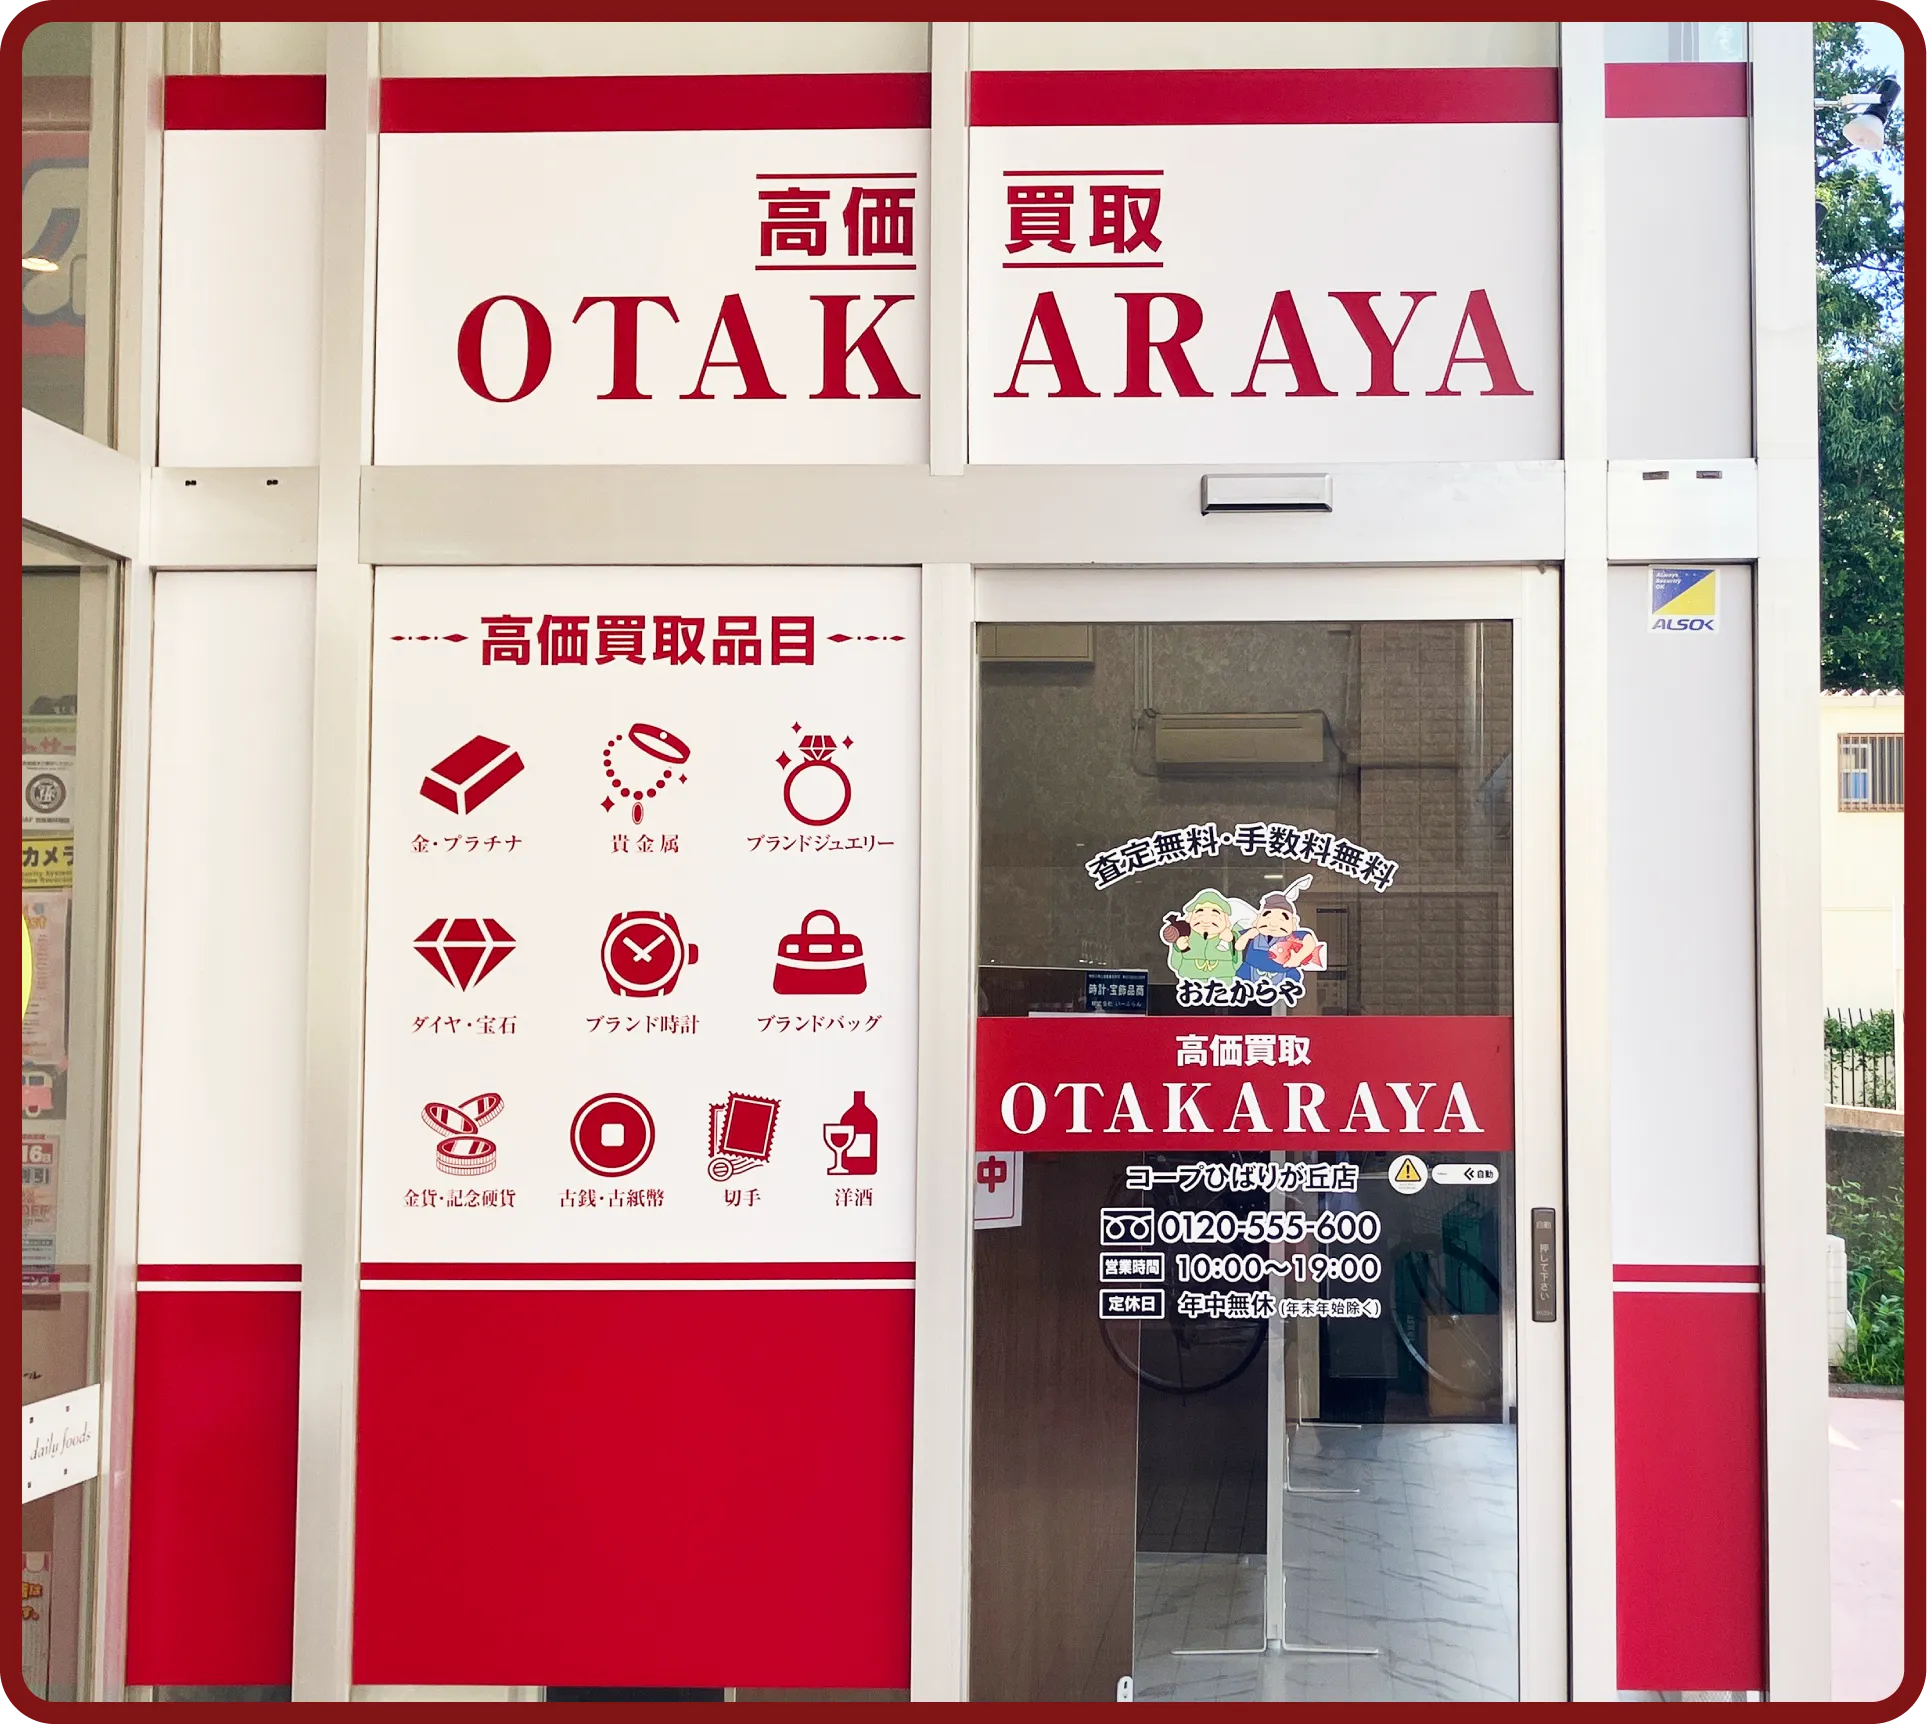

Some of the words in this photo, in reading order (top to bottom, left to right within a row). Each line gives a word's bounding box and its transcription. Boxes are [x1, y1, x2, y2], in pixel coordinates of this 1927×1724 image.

[1652, 618, 1715, 631] ALSOK
[480, 613, 816, 666] 高価買取品目
[411, 833, 522, 853] 金・プラチナ
[611, 833, 680, 854] 貴金属
[747, 833, 895, 853] ブランドジュエリー
[1087, 823, 1399, 890] 査定無料・手数料無料
[1088, 983, 1145, 997] 時計・宝飾品商
[1176, 978, 1306, 1007] おたからや
[411, 1015, 517, 1034] ダイヤ・宝石
[586, 1015, 699, 1035] ブランド時計
[757, 1015, 883, 1033] ブランドバッグ
[1175, 1033, 1312, 1067] 高価買取
[1001, 1081, 1485, 1135] OTAKARAYA
[977, 1155, 1007, 1193] 中
[1126, 1163, 1359, 1191] コープひばりが丘店
[1477, 1169, 1494, 1179] 自動
[403, 1188, 517, 1208] 金貨・記念硬貨
[559, 1188, 665, 1209] 古銭・古紙幣
[724, 1188, 762, 1208] 切手
[834, 1188, 874, 1208] 洋酒
[1158, 1211, 1381, 1243] 0120-555-600
[1104, 1258, 1160, 1276] 営業時間
[1108, 1295, 1157, 1312] 定休日
[1179, 1291, 1275, 1318] 年中無休
[29, 1432, 59, 1461] daily
[59, 1421, 92, 1456] foods
